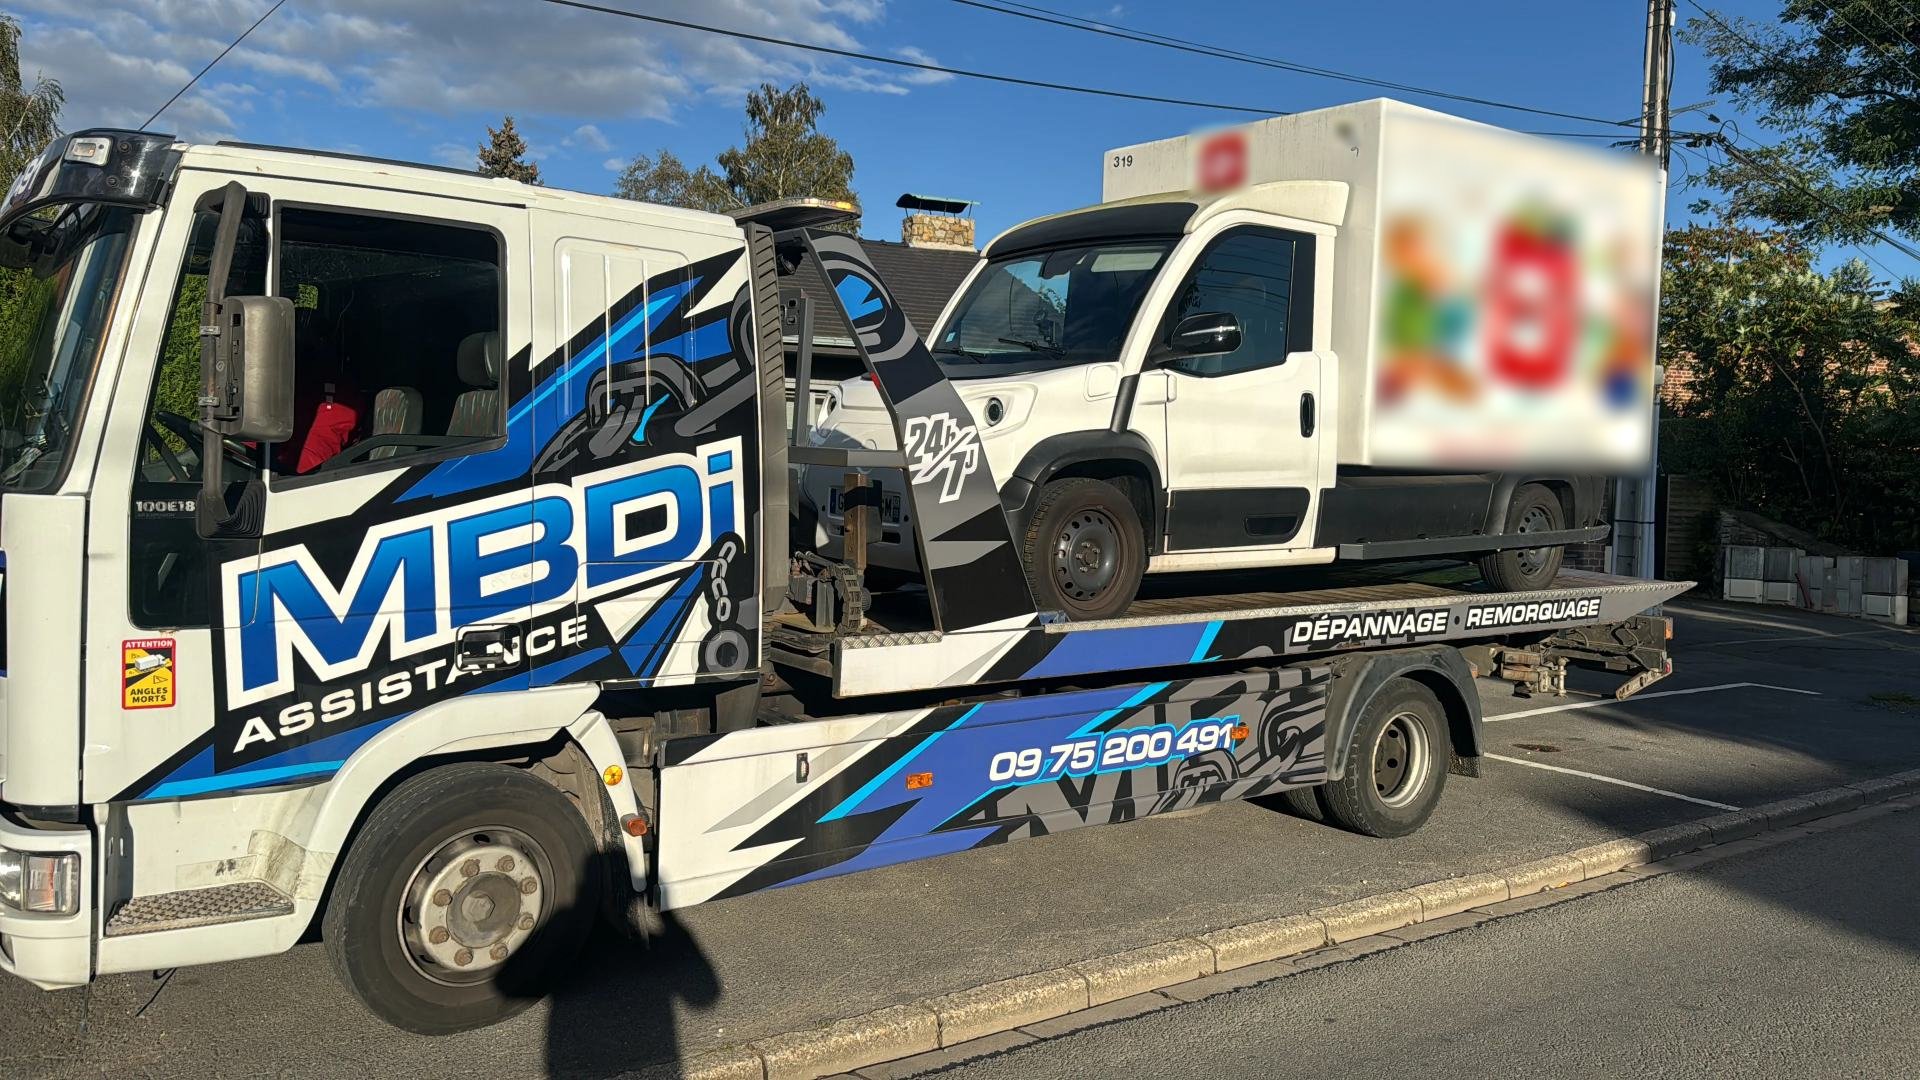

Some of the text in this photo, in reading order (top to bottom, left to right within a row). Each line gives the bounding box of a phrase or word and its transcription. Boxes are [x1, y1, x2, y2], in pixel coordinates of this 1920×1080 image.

[1113, 154, 1133, 168] 319
[136, 500, 196, 512] 100E18
[221, 435, 745, 711] MBDi
[1292, 599, 1600, 643] DÉPANNAGE REMORQUAGE
[125, 640, 173, 649] ATTENTION
[130, 687, 168, 696] ANGLES
[132, 695, 167, 703] MORTS
[989, 723, 1234, 782] 09 75 200 491
